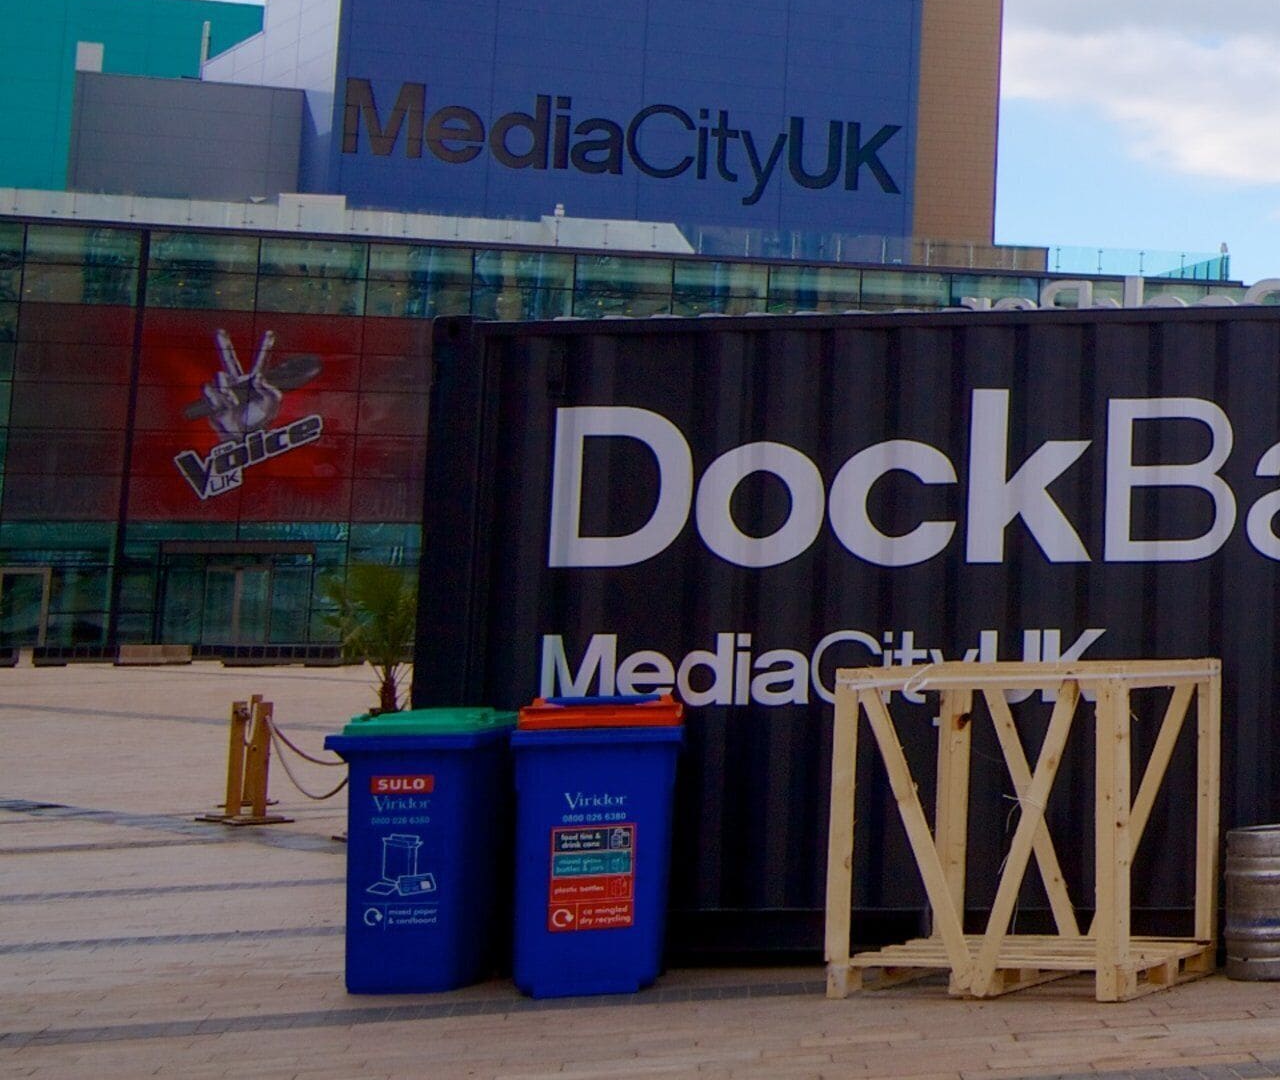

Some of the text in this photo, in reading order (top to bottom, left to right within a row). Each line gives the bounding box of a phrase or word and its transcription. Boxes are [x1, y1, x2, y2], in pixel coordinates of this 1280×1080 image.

[342, 76, 902, 205] MediaCityUK
[174, 415, 323, 499] Voice
[210, 472, 240, 493] UK
[378, 777, 426, 791] SULO
[373, 794, 431, 812] Viridor
[564, 792, 627, 810] Viridor
[595, 905, 628, 916] mingled
[579, 915, 631, 925] dry recycling
